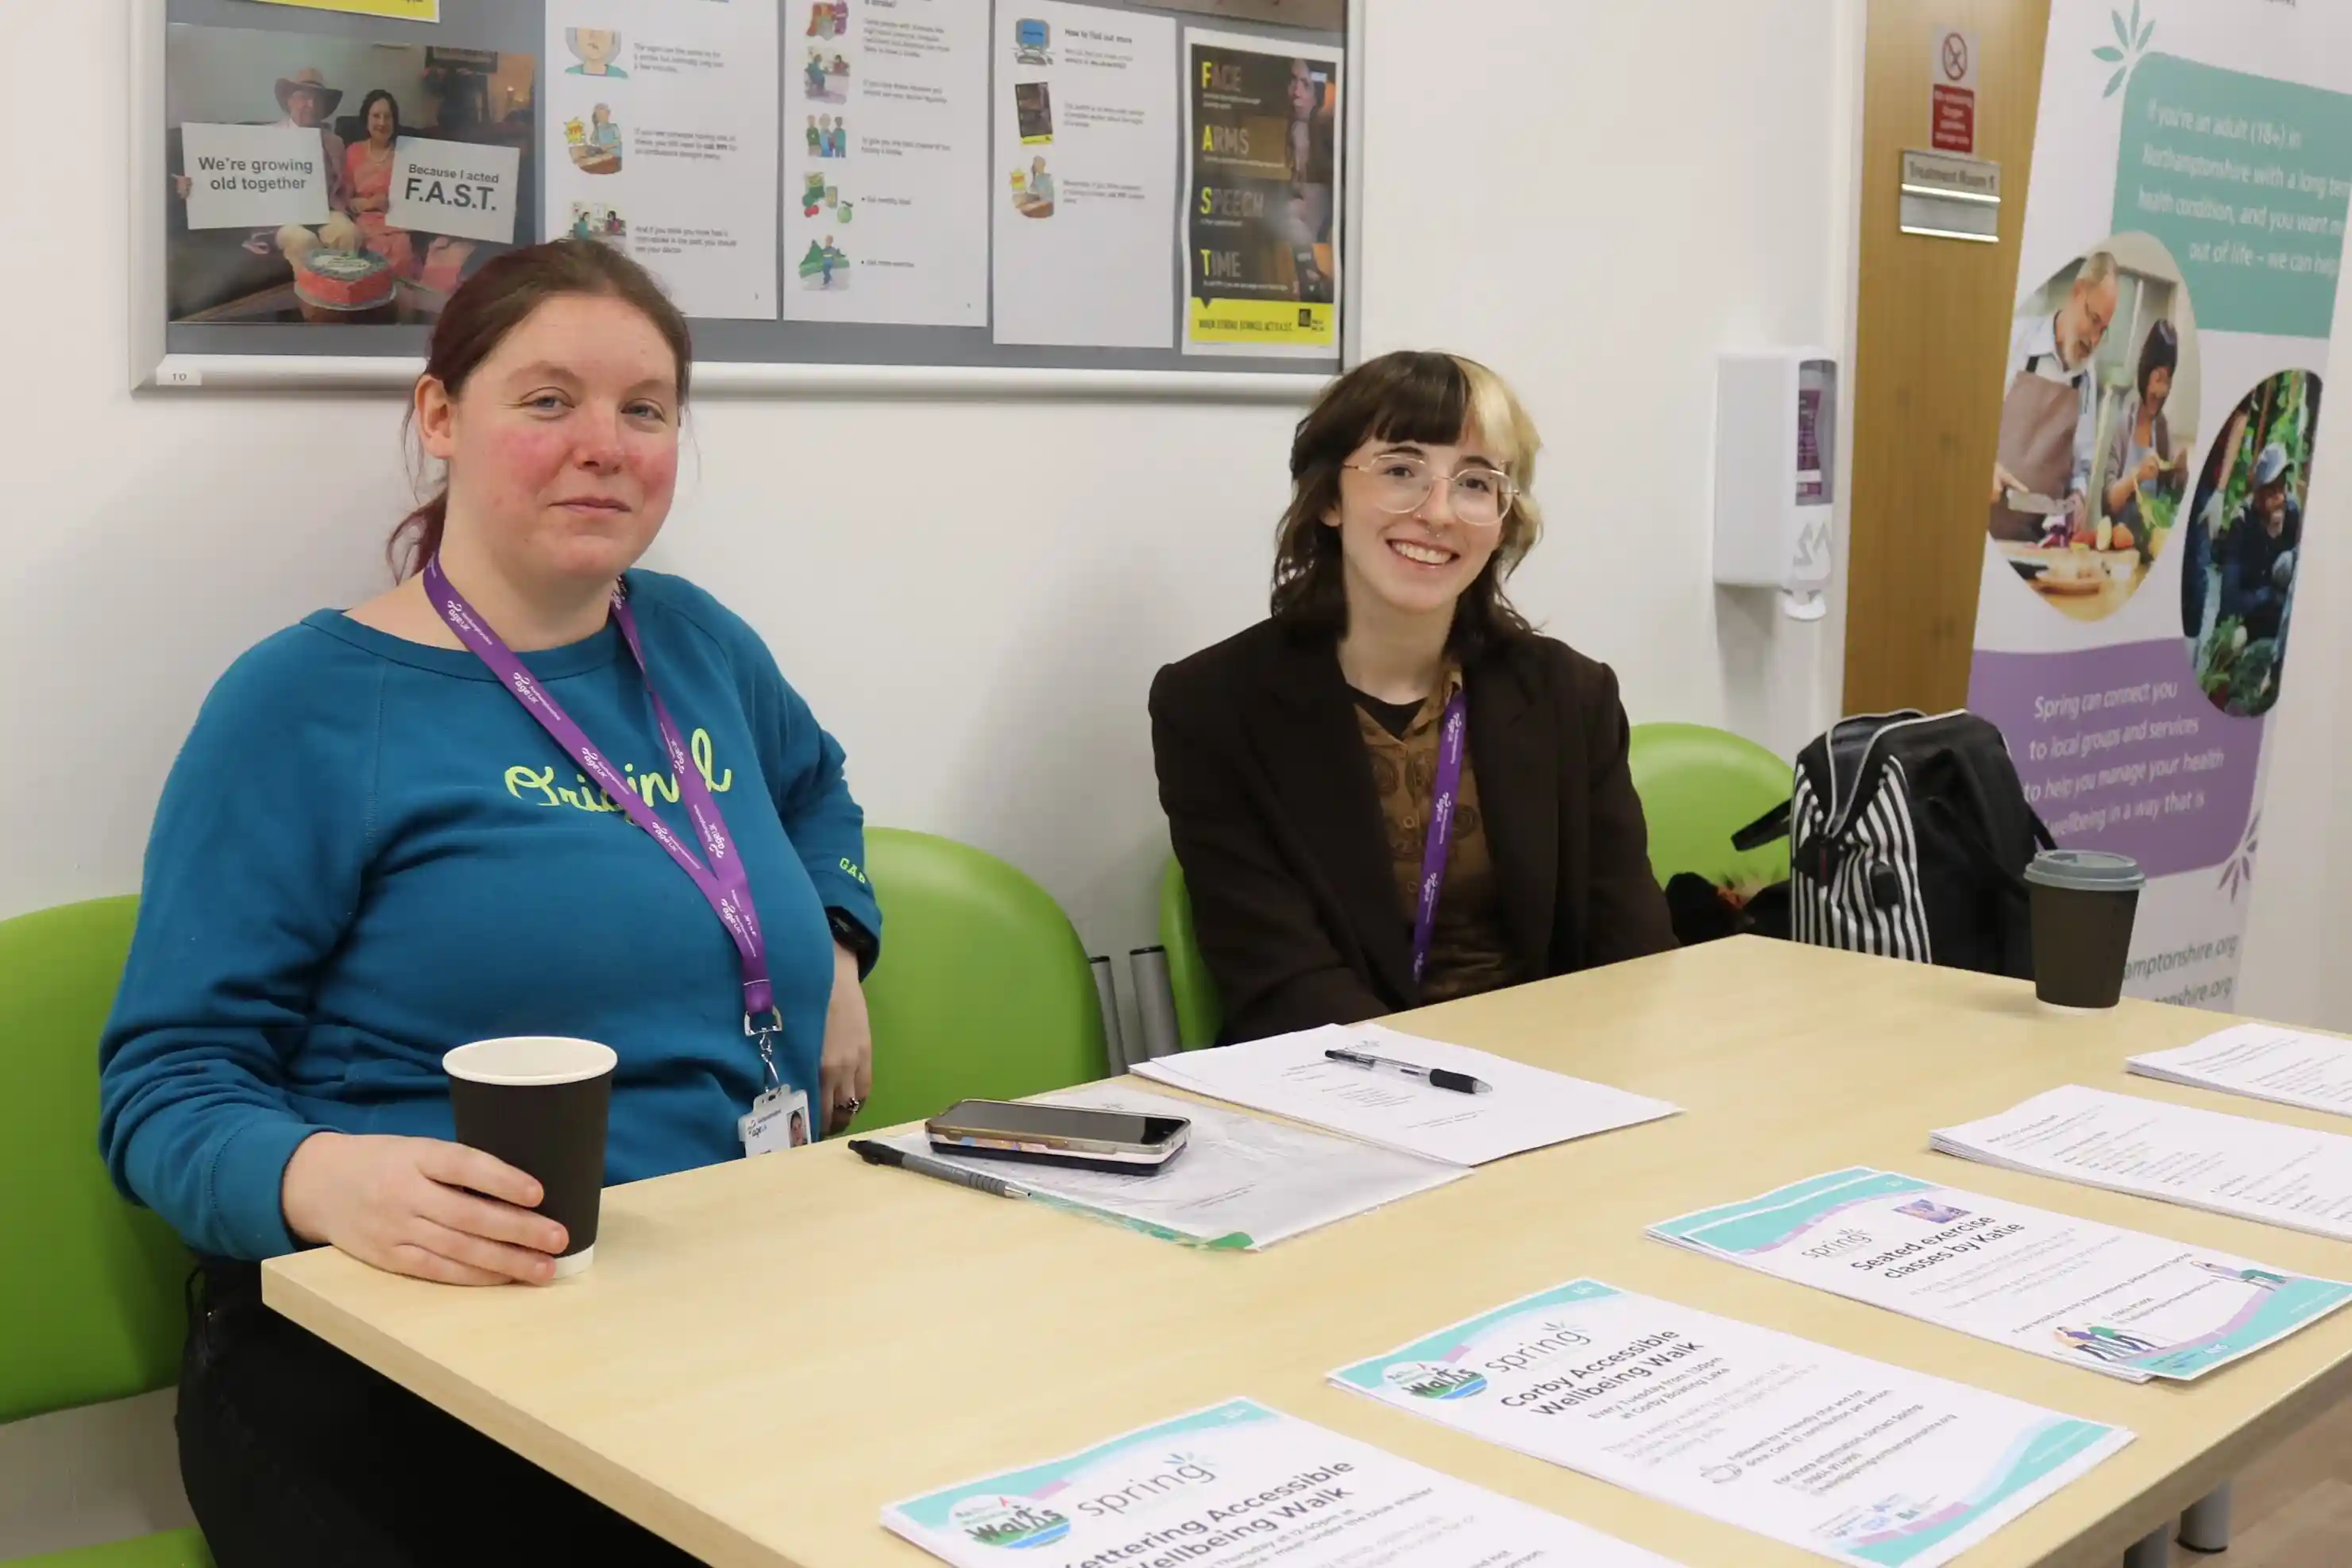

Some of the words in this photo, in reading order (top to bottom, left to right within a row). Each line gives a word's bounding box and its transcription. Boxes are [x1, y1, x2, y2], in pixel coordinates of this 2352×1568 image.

[1202, 61, 1241, 93] FACE
[1203, 125, 1249, 156] ARMS
[199, 156, 246, 172] We're
[251, 157, 313, 176] growing
[210, 176, 237, 191] old
[241, 176, 306, 194] together
[408, 164, 457, 180] Because
[465, 172, 499, 184] acted
[405, 179, 498, 212] F.A.S.T.
[1200, 186, 1265, 218] SPEECH
[1200, 248, 1241, 278] TIME
[2033, 693, 2080, 724] Spring
[2081, 692, 2103, 713] can
[2104, 682, 2151, 708] connect
[2152, 681, 2179, 706] you
[2029, 739, 2048, 761] to
[2050, 732, 2080, 758] local
[2081, 728, 2122, 759] groups
[2122, 719, 2147, 743] and
[2149, 715, 2200, 740] services
[504, 728, 732, 827] Oriinl
[2045, 776, 2074, 800] help
[2074, 772, 2098, 799] you
[2098, 763, 2146, 787] manage
[2149, 757, 2180, 783] your
[2183, 748, 2225, 770] health
[2164, 791, 2192, 813] that
[1802, 1234, 1872, 1258] spring
[1851, 1243, 1925, 1270] Seated
[1921, 1218, 1995, 1245] exercise
[1884, 1252, 1954, 1278] classes
[1944, 1242, 1980, 1253] by
[1970, 1225, 2025, 1242] Katie
[1485, 1326, 1591, 1373] spring
[1500, 1377, 1574, 1406] Corby
[1570, 1332, 1679, 1379] Accessible
[1531, 1367, 1652, 1415] Wellbeing
[1641, 1342, 1704, 1366] Walk
[1588, 1404, 1623, 1419] Every
[1618, 1385, 1666, 1404] Tuesday
[1660, 1374, 1690, 1385] from
[1632, 1398, 1667, 1413] Corby
[1702, 1369, 1730, 1381] Lake
[1077, 1460, 1216, 1516] spring
[1206, 1461, 1356, 1524] Accessible
[1270, 1485, 1355, 1520] Walk
[1211, 1541, 1276, 1567] Thursday
